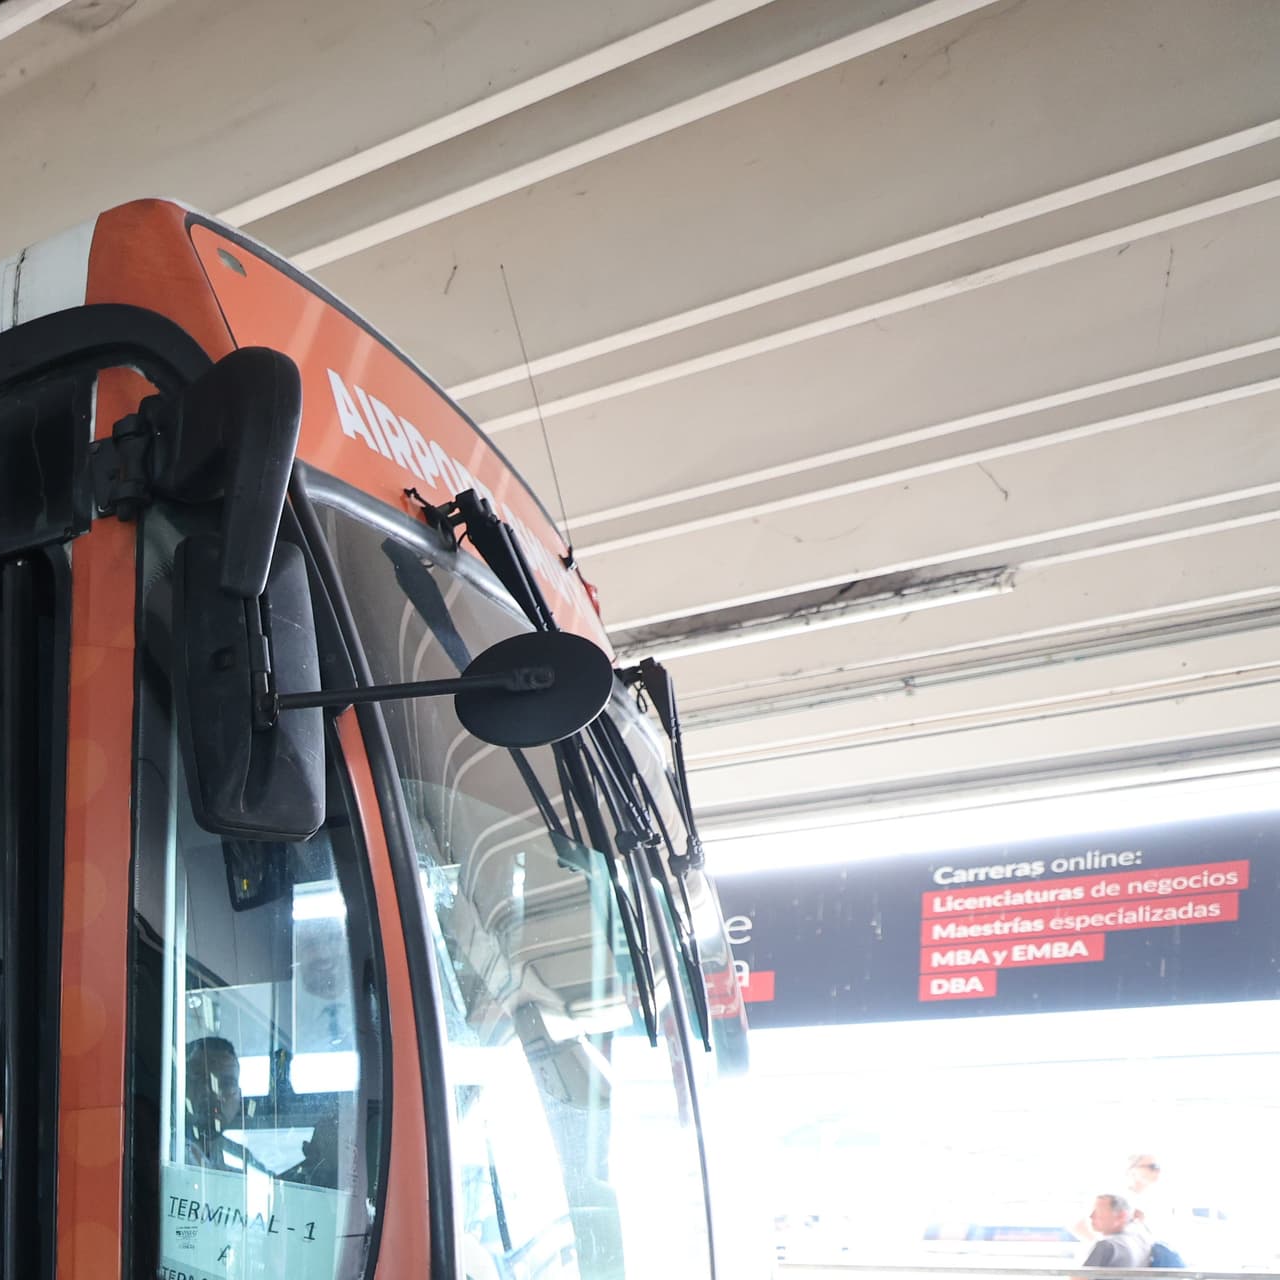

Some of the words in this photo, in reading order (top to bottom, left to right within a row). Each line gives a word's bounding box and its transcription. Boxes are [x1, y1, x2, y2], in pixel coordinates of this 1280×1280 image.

[933, 858, 1045, 885] Carreras
[1050, 849, 1142, 873] online:
[933, 883, 1085, 913] Licenciaturas
[1090, 878, 1121, 899] de
[1126, 867, 1239, 898] negocios
[931, 915, 1045, 942] Maestrías
[1049, 899, 1221, 933] especializadas
[931, 945, 989, 969] MBA
[993, 949, 1008, 967] y
[1011, 939, 1088, 962] EMBA
[930, 976, 984, 995] DBA
[303, 1221, 317, 1241] 1
